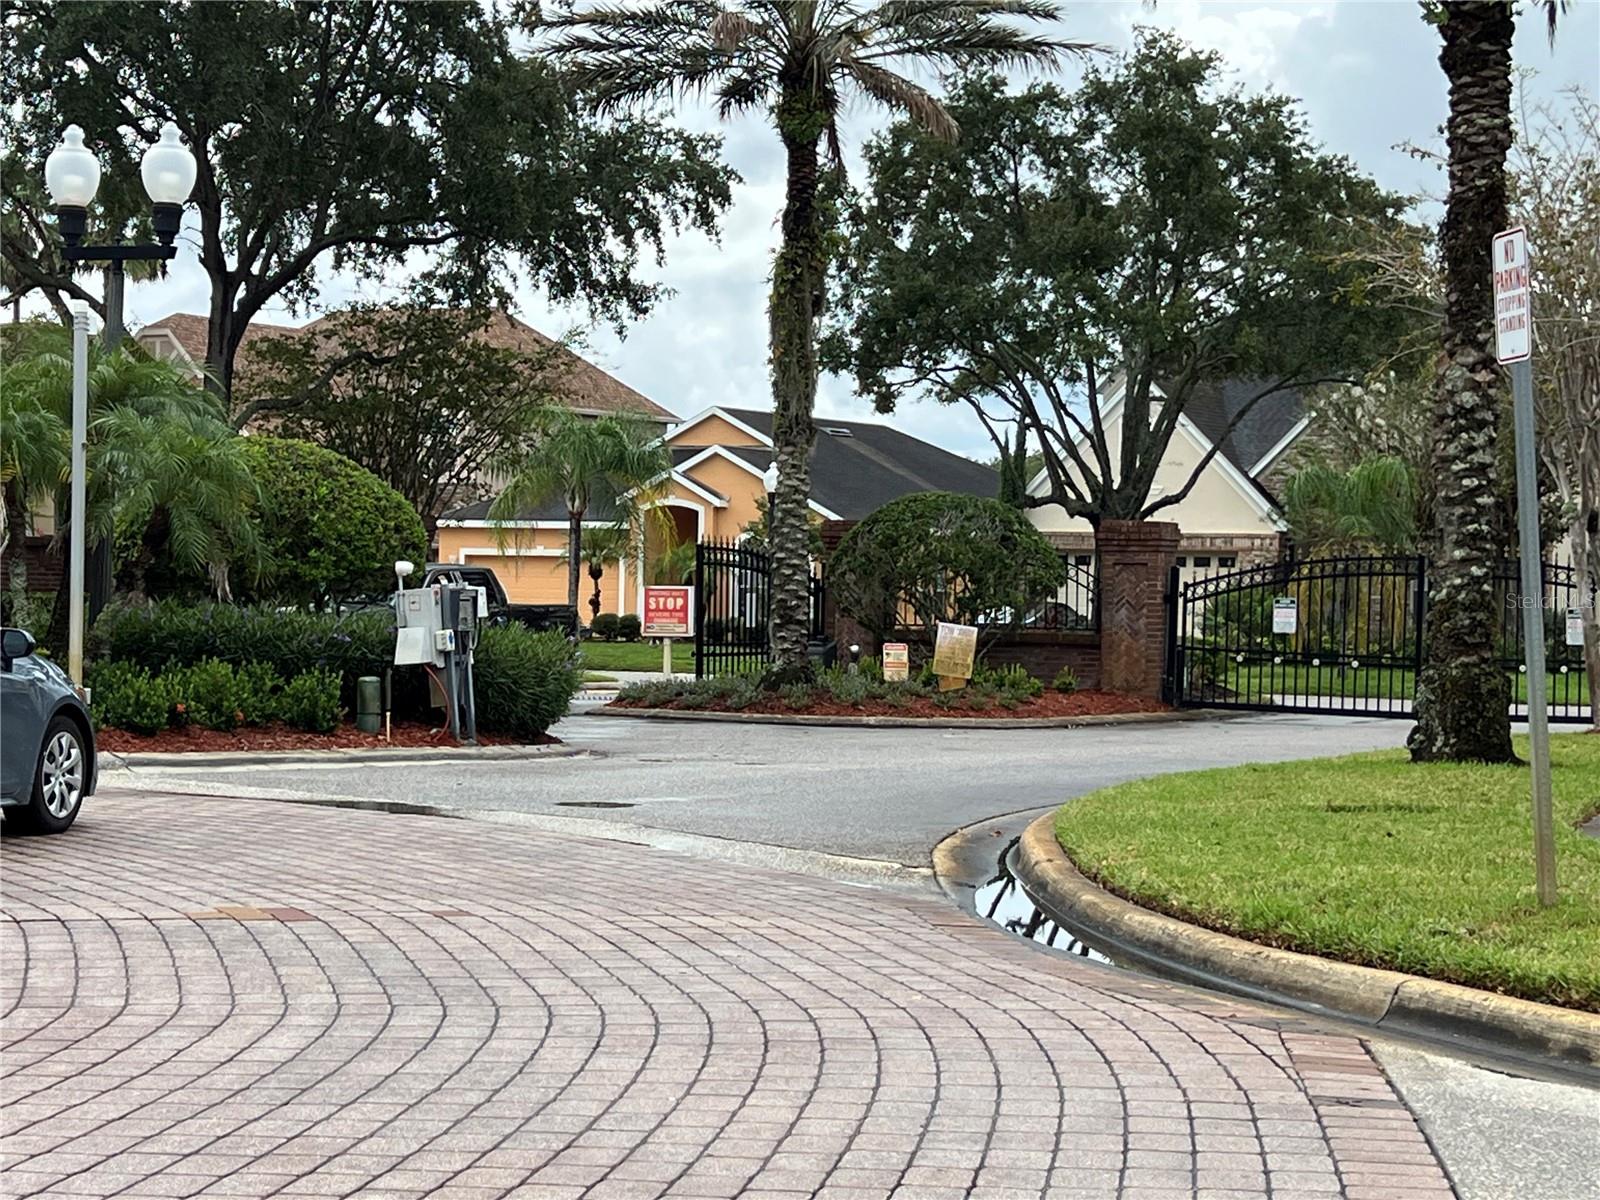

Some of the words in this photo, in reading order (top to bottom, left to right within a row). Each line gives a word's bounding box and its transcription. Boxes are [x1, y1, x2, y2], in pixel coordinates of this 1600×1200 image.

[1503, 239, 1514, 263] NO
[1495, 266, 1527, 293] PARKING
[1498, 294, 1525, 314] STOPPING
[1499, 314, 1525, 333] STANDING
[649, 597, 684, 610] STOP
